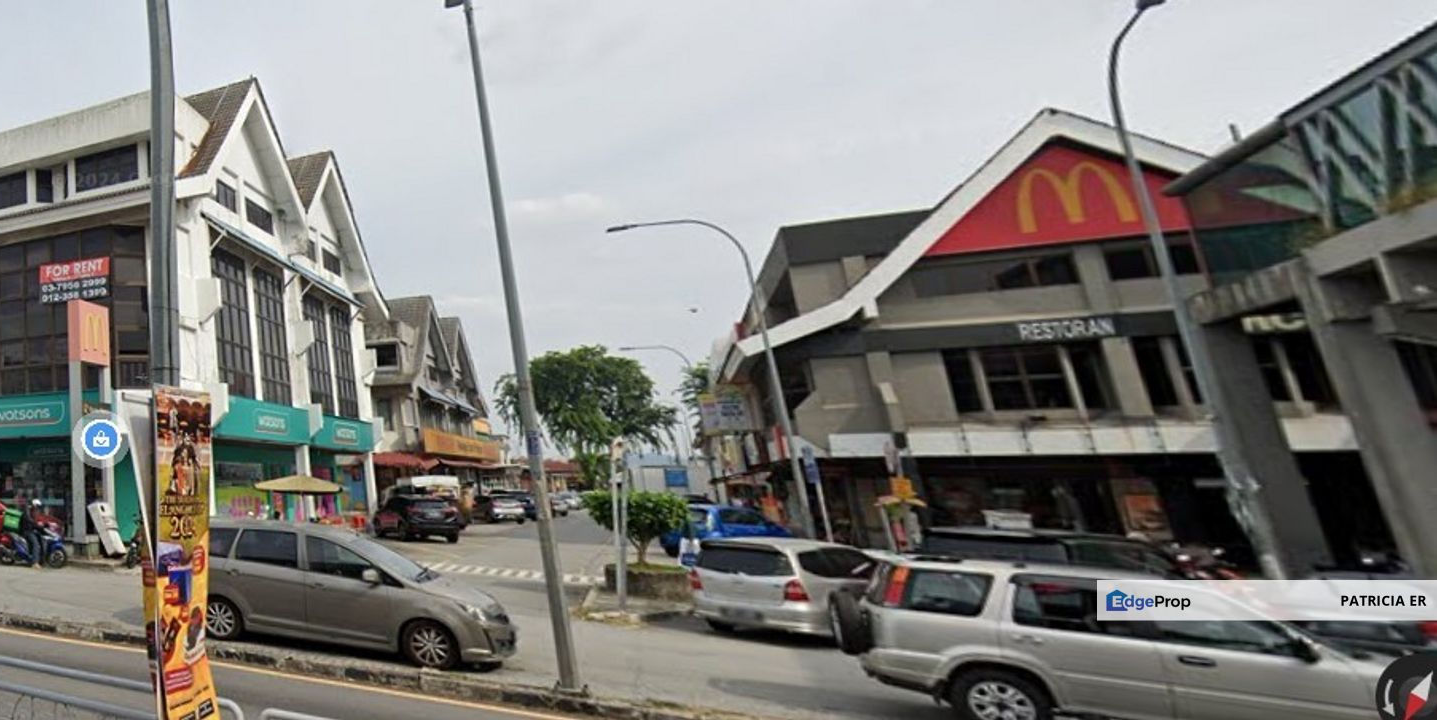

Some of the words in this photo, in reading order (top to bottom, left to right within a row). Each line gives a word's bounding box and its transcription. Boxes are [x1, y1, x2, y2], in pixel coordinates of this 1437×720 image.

[45, 264, 70, 277] FOR
[73, 258, 103, 274] RENT
[1018, 317, 1116, 341] RESTORAN
